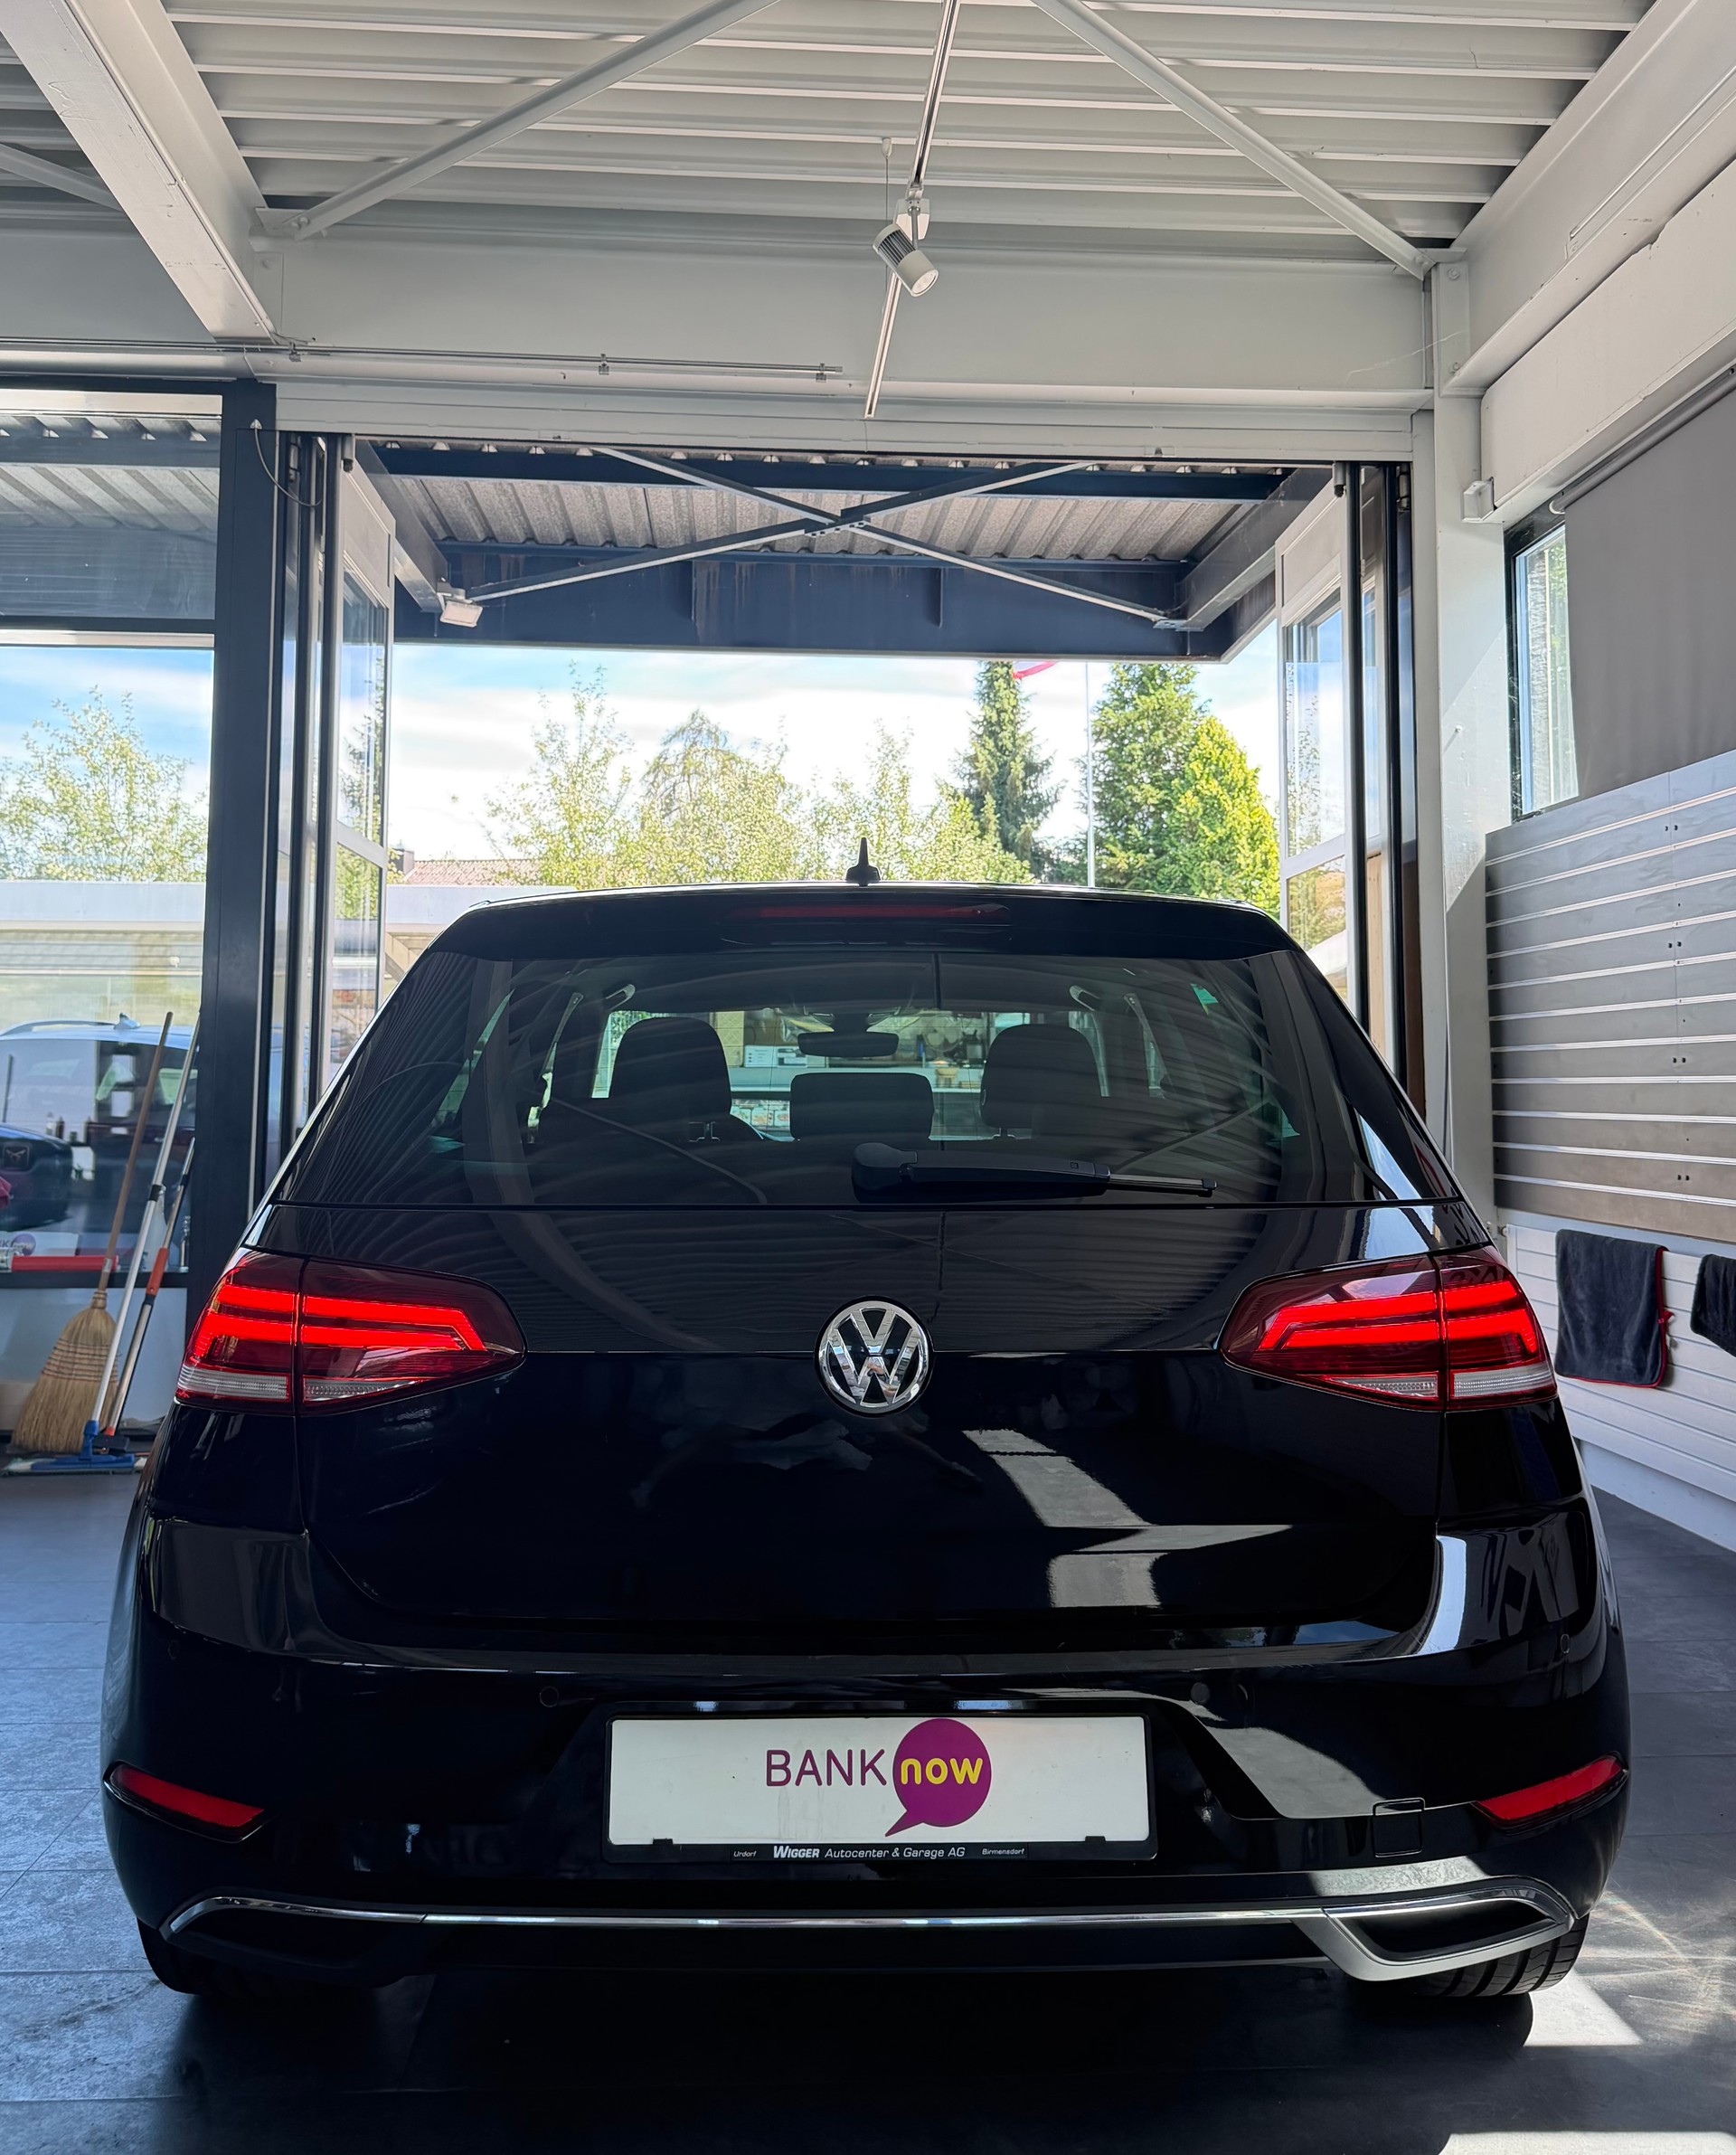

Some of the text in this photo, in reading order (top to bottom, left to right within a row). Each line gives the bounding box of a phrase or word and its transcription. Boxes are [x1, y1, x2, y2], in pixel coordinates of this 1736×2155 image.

[766, 1749, 983, 1787] BANK now
[825, 1848, 889, 1858] Autocenter
[891, 1847, 901, 1857] &
[903, 1847, 945, 1859] Garage
[948, 1847, 966, 1857] AG
[982, 1848, 1025, 1856] Birmensdorf
